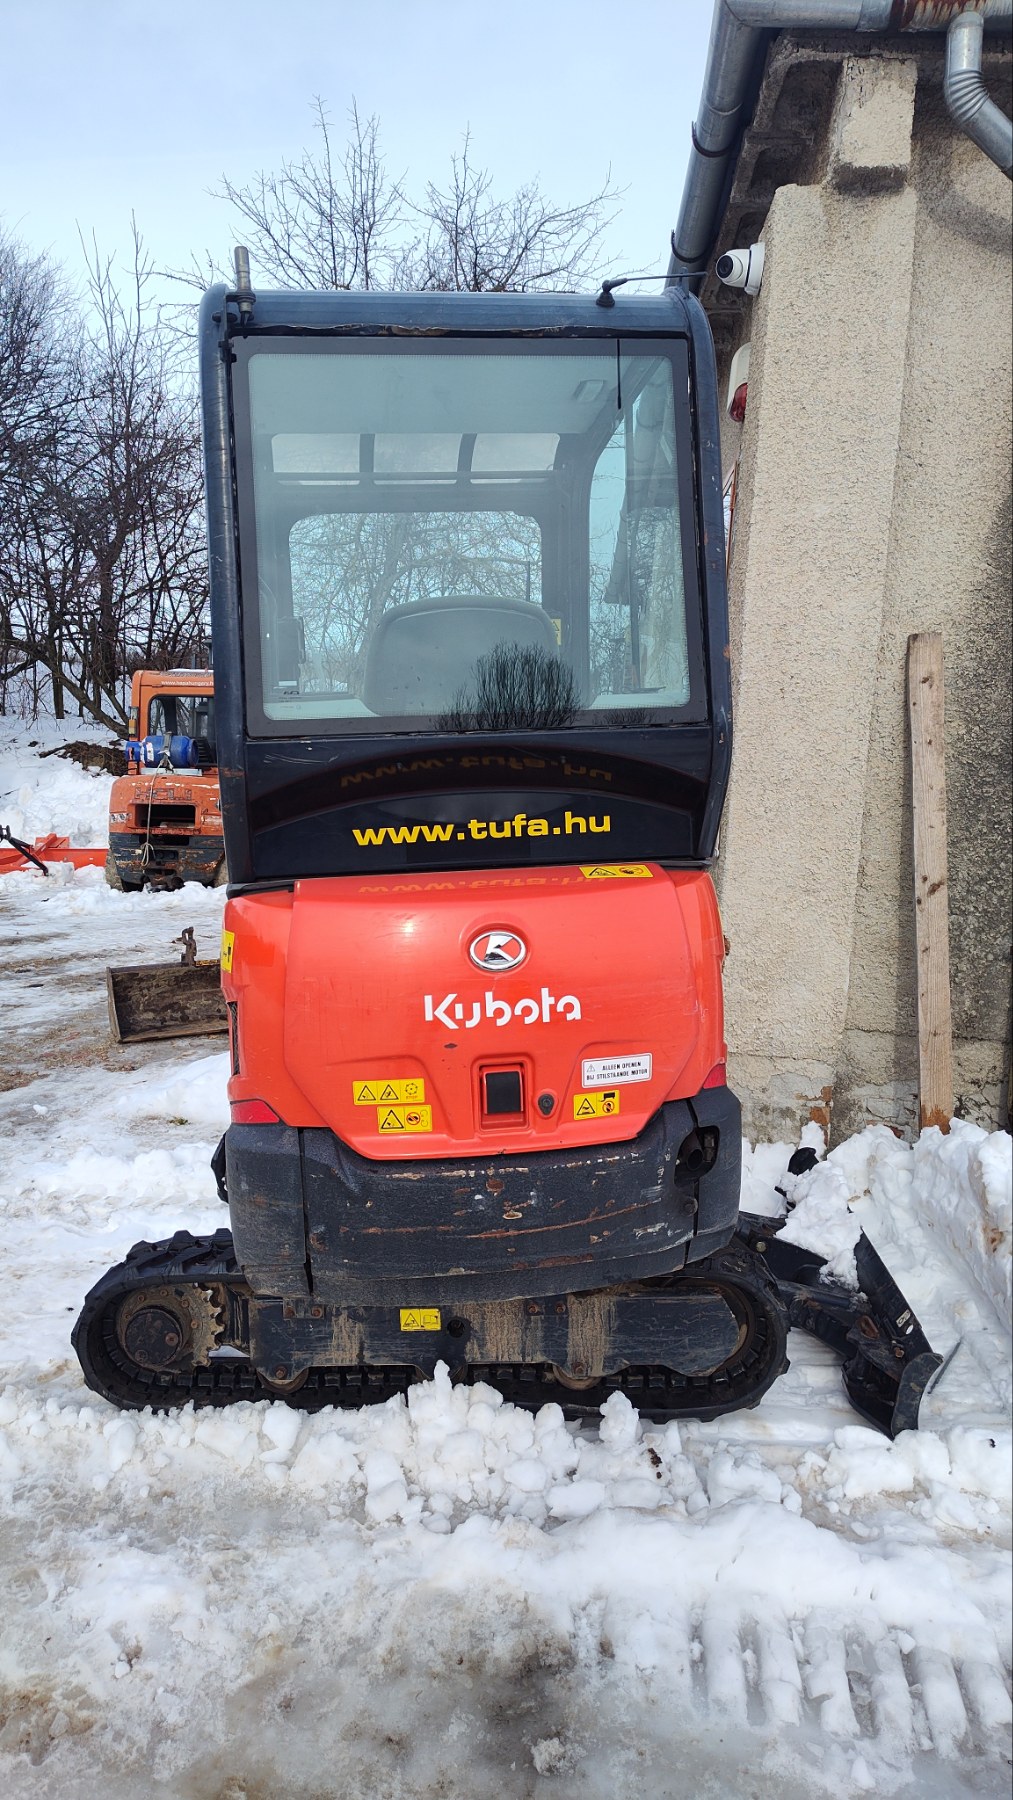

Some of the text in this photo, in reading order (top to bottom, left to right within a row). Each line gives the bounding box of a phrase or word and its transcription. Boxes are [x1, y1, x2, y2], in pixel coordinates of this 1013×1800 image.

[352, 811, 611, 846] www.tufa.hu
[423, 987, 582, 1030] Kubota
[597, 1071, 629, 1079] STILSTAANDE
